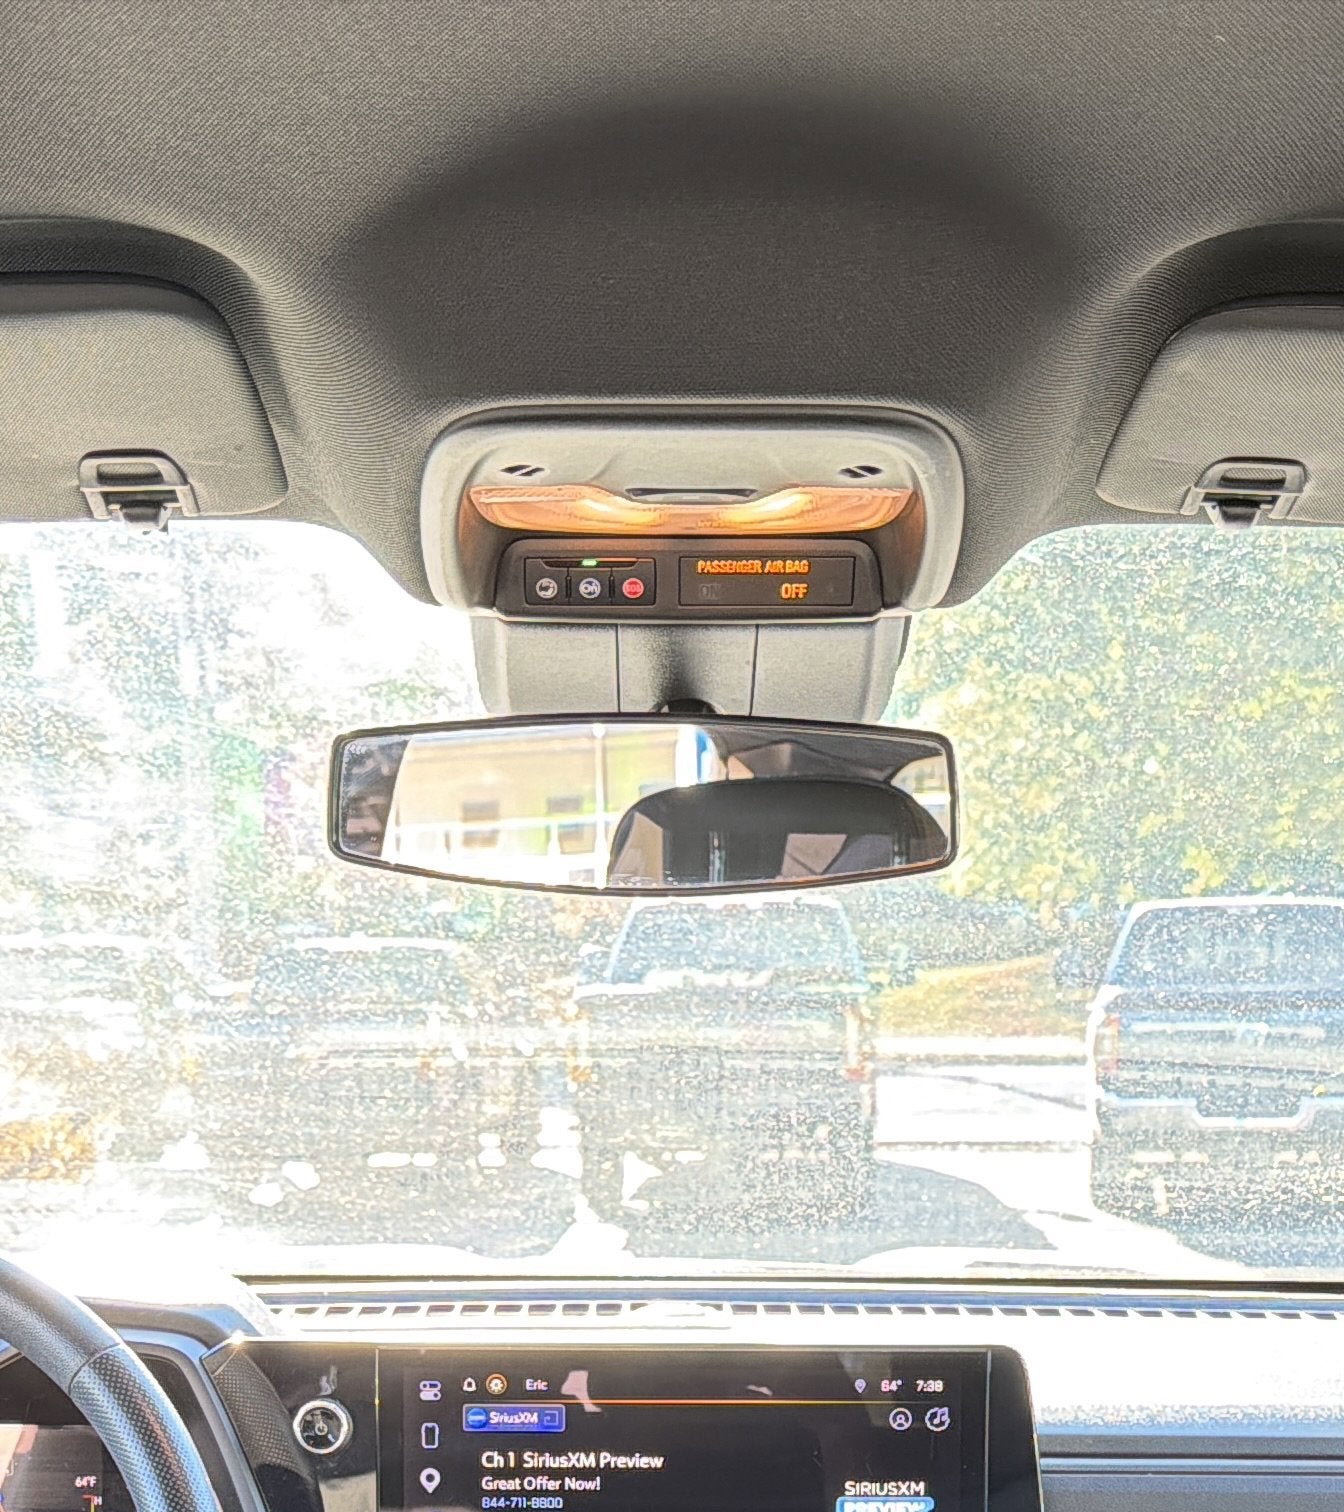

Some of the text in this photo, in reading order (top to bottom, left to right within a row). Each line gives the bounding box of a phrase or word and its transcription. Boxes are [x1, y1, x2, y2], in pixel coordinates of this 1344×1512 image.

[697, 559, 809, 575] PASSENGER AIR BAG
[780, 582, 809, 600] OFF
[525, 1378, 549, 1392] Eric
[489, 1411, 538, 1425] SiriusXM
[481, 1451, 664, 1468] Ch 1 SiriusXM Preview
[481, 1475, 601, 1491] Great Offer Now!
[844, 1481, 925, 1496] SIRIUSXM
[481, 1496, 563, 1509] 844-711-8800
